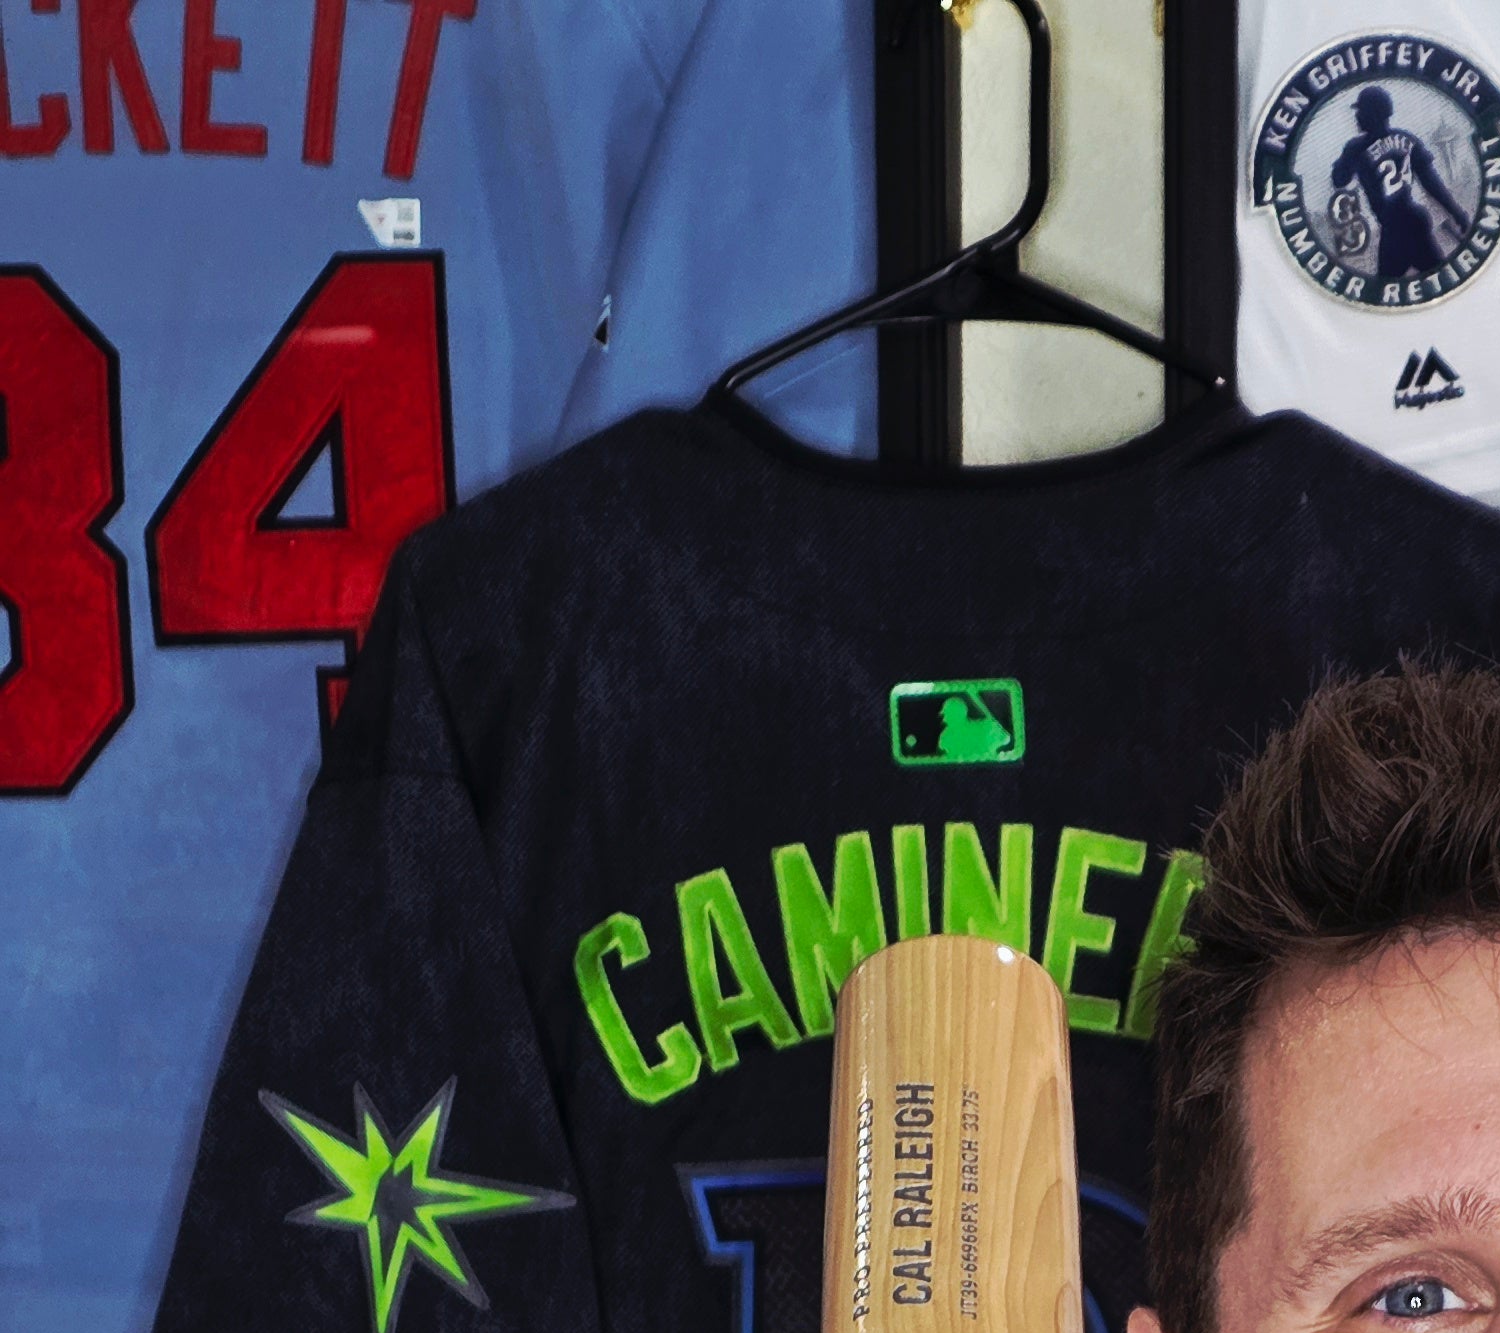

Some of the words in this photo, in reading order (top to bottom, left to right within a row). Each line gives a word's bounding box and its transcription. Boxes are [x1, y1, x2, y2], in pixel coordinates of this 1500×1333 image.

[1264, 87, 1310, 149] KEN
[1307, 40, 1435, 90] GRIFFEY
[1441, 61, 1481, 103] JR.
[1377, 151, 1415, 196] 24
[1275, 182, 1366, 300] NUMBER
[893, 1083, 935, 1229] RALEIGH
[961, 1139, 980, 1195] BIRCH
[892, 1239, 933, 1305] CAL
